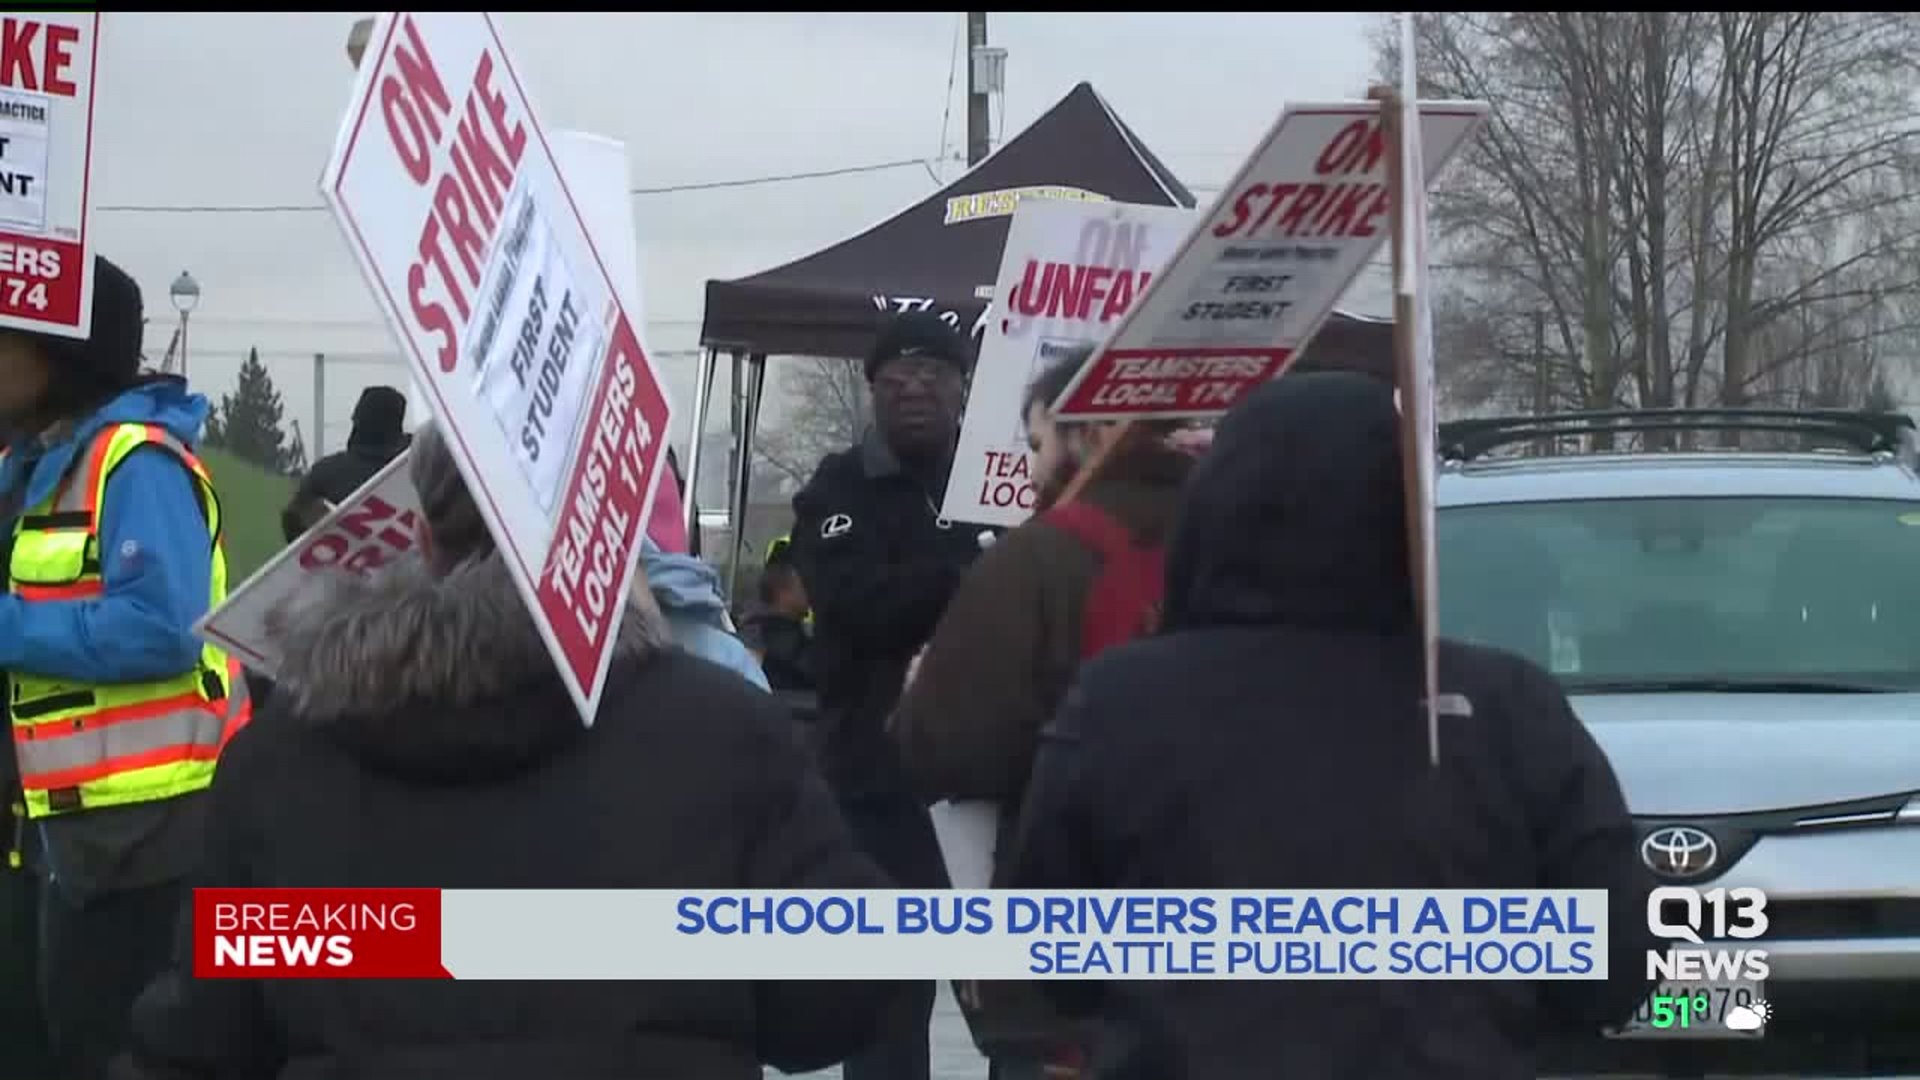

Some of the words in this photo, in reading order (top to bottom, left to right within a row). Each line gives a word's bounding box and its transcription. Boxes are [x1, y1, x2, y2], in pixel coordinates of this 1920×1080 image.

[0, 18, 80, 97] KE
[378, 14, 452, 186] ON
[408, 48, 527, 373] STRIKE
[1182, 301, 1293, 321] STUDENT
[1221, 274, 1294, 293] FIRST
[510, 275, 548, 390] FIRST
[521, 288, 580, 463] STUDENT
[1107, 355, 1273, 380] TEAMSTERS
[1091, 383, 1178, 406] LOCAL
[551, 351, 636, 610] TEAMSTERS
[984, 452, 1032, 479] TEA
[575, 499, 630, 647] LOCAL
[620, 407, 652, 495] 174
